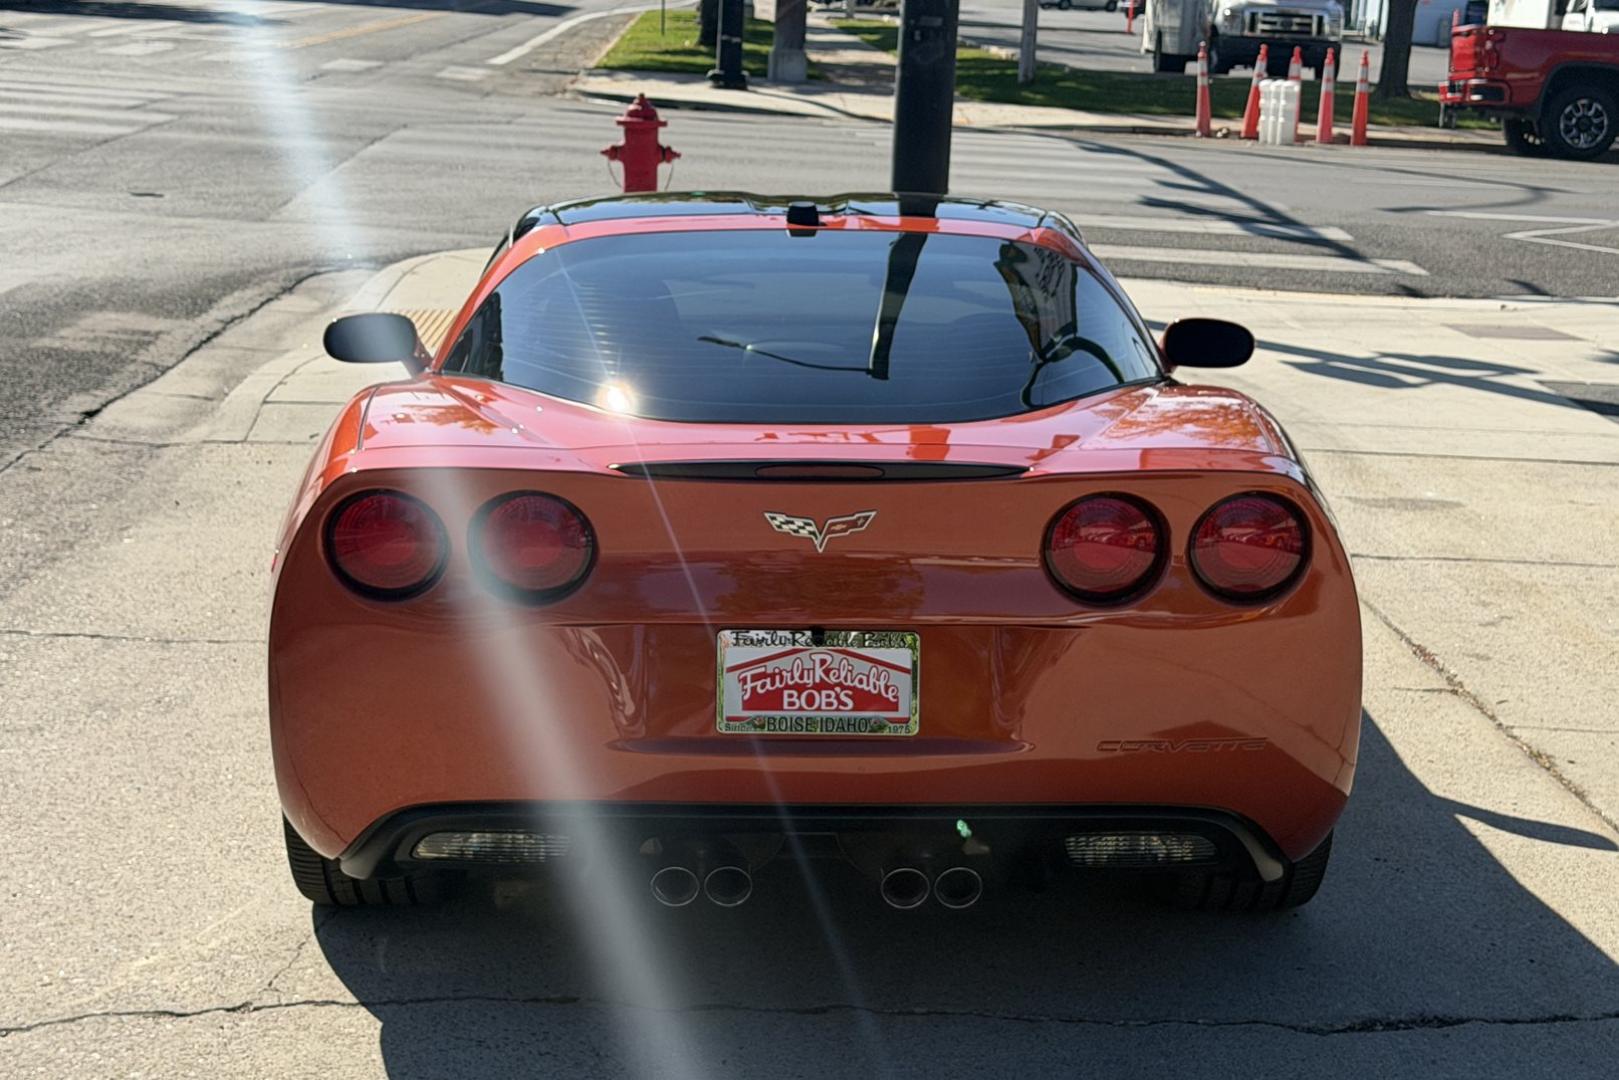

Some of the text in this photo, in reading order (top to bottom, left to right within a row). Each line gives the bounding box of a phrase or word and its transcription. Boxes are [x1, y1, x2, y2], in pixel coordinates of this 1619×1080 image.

[730, 630, 787, 648] Fairly
[788, 630, 858, 648] Reable
[738, 652, 899, 703] Fairly Reliable
[782, 687, 854, 711] BOB'S
[767, 716, 868, 733] BOISE IDAHO
[1096, 736, 1269, 753] CORVETTE
